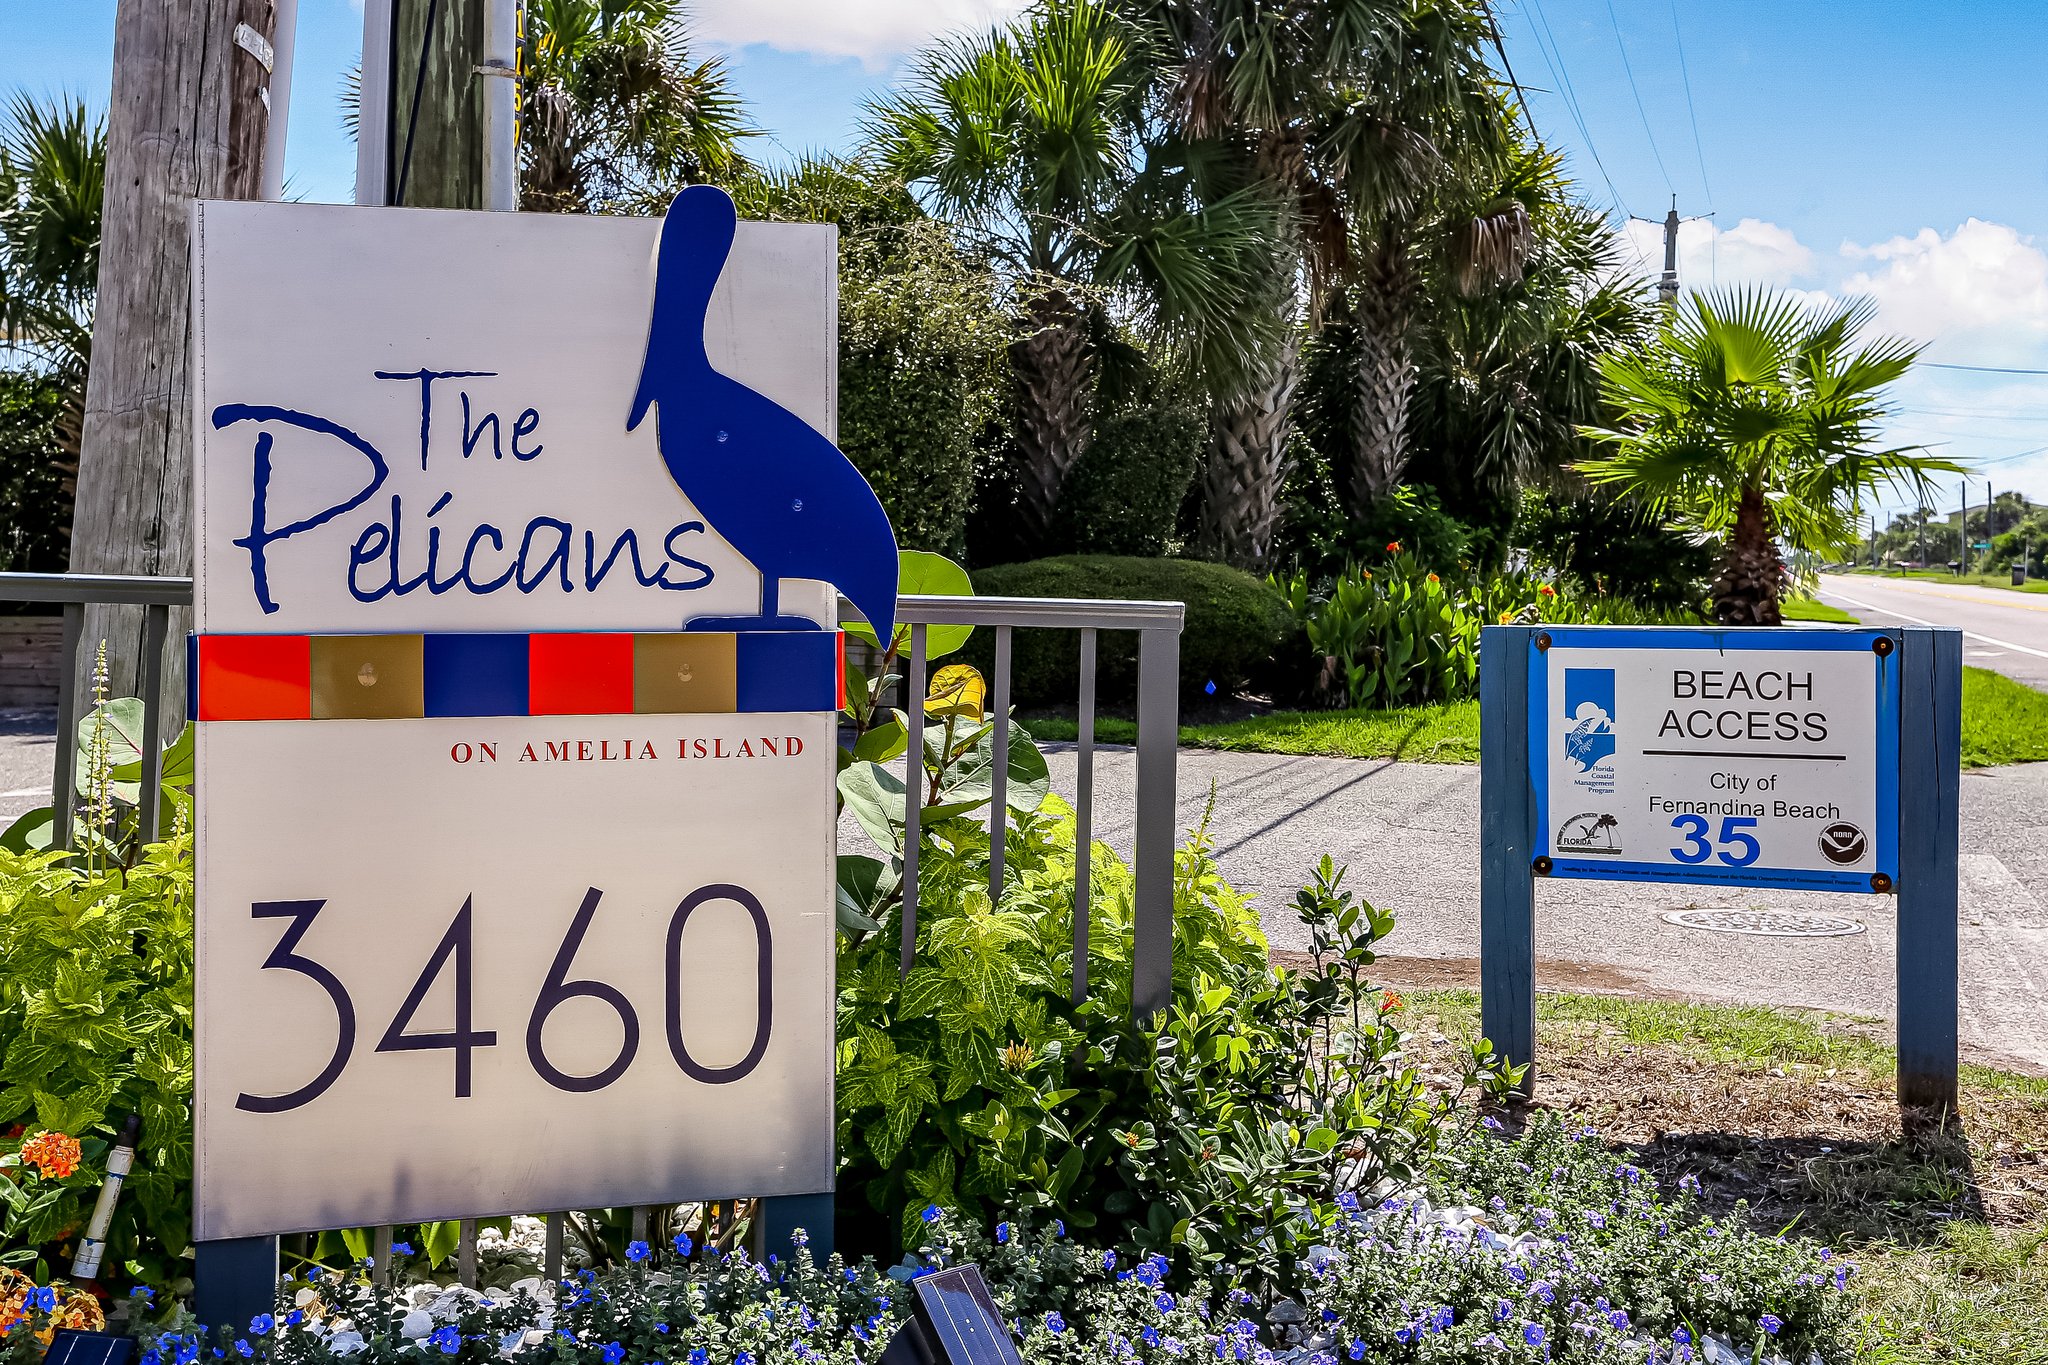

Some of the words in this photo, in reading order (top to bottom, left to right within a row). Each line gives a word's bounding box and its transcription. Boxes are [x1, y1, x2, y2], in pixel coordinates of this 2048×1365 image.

[375, 368, 543, 471] The
[212, 402, 715, 614] Pelicans
[1673, 670, 1812, 701] BEACH
[1657, 709, 1828, 741] ACCESS
[450, 742, 498, 763] ON
[518, 740, 658, 762] AMELIA
[677, 736, 804, 759] ISLAND
[1588, 787, 1615, 795] Program
[1710, 772, 1749, 793] City
[1757, 774, 1777, 791] of
[1649, 796, 1765, 816] Fernandina
[1773, 801, 1840, 819] Beach
[1563, 838, 1593, 846] FLORIDA
[1669, 814, 1761, 867] 35
[235, 882, 773, 1113] 3460
